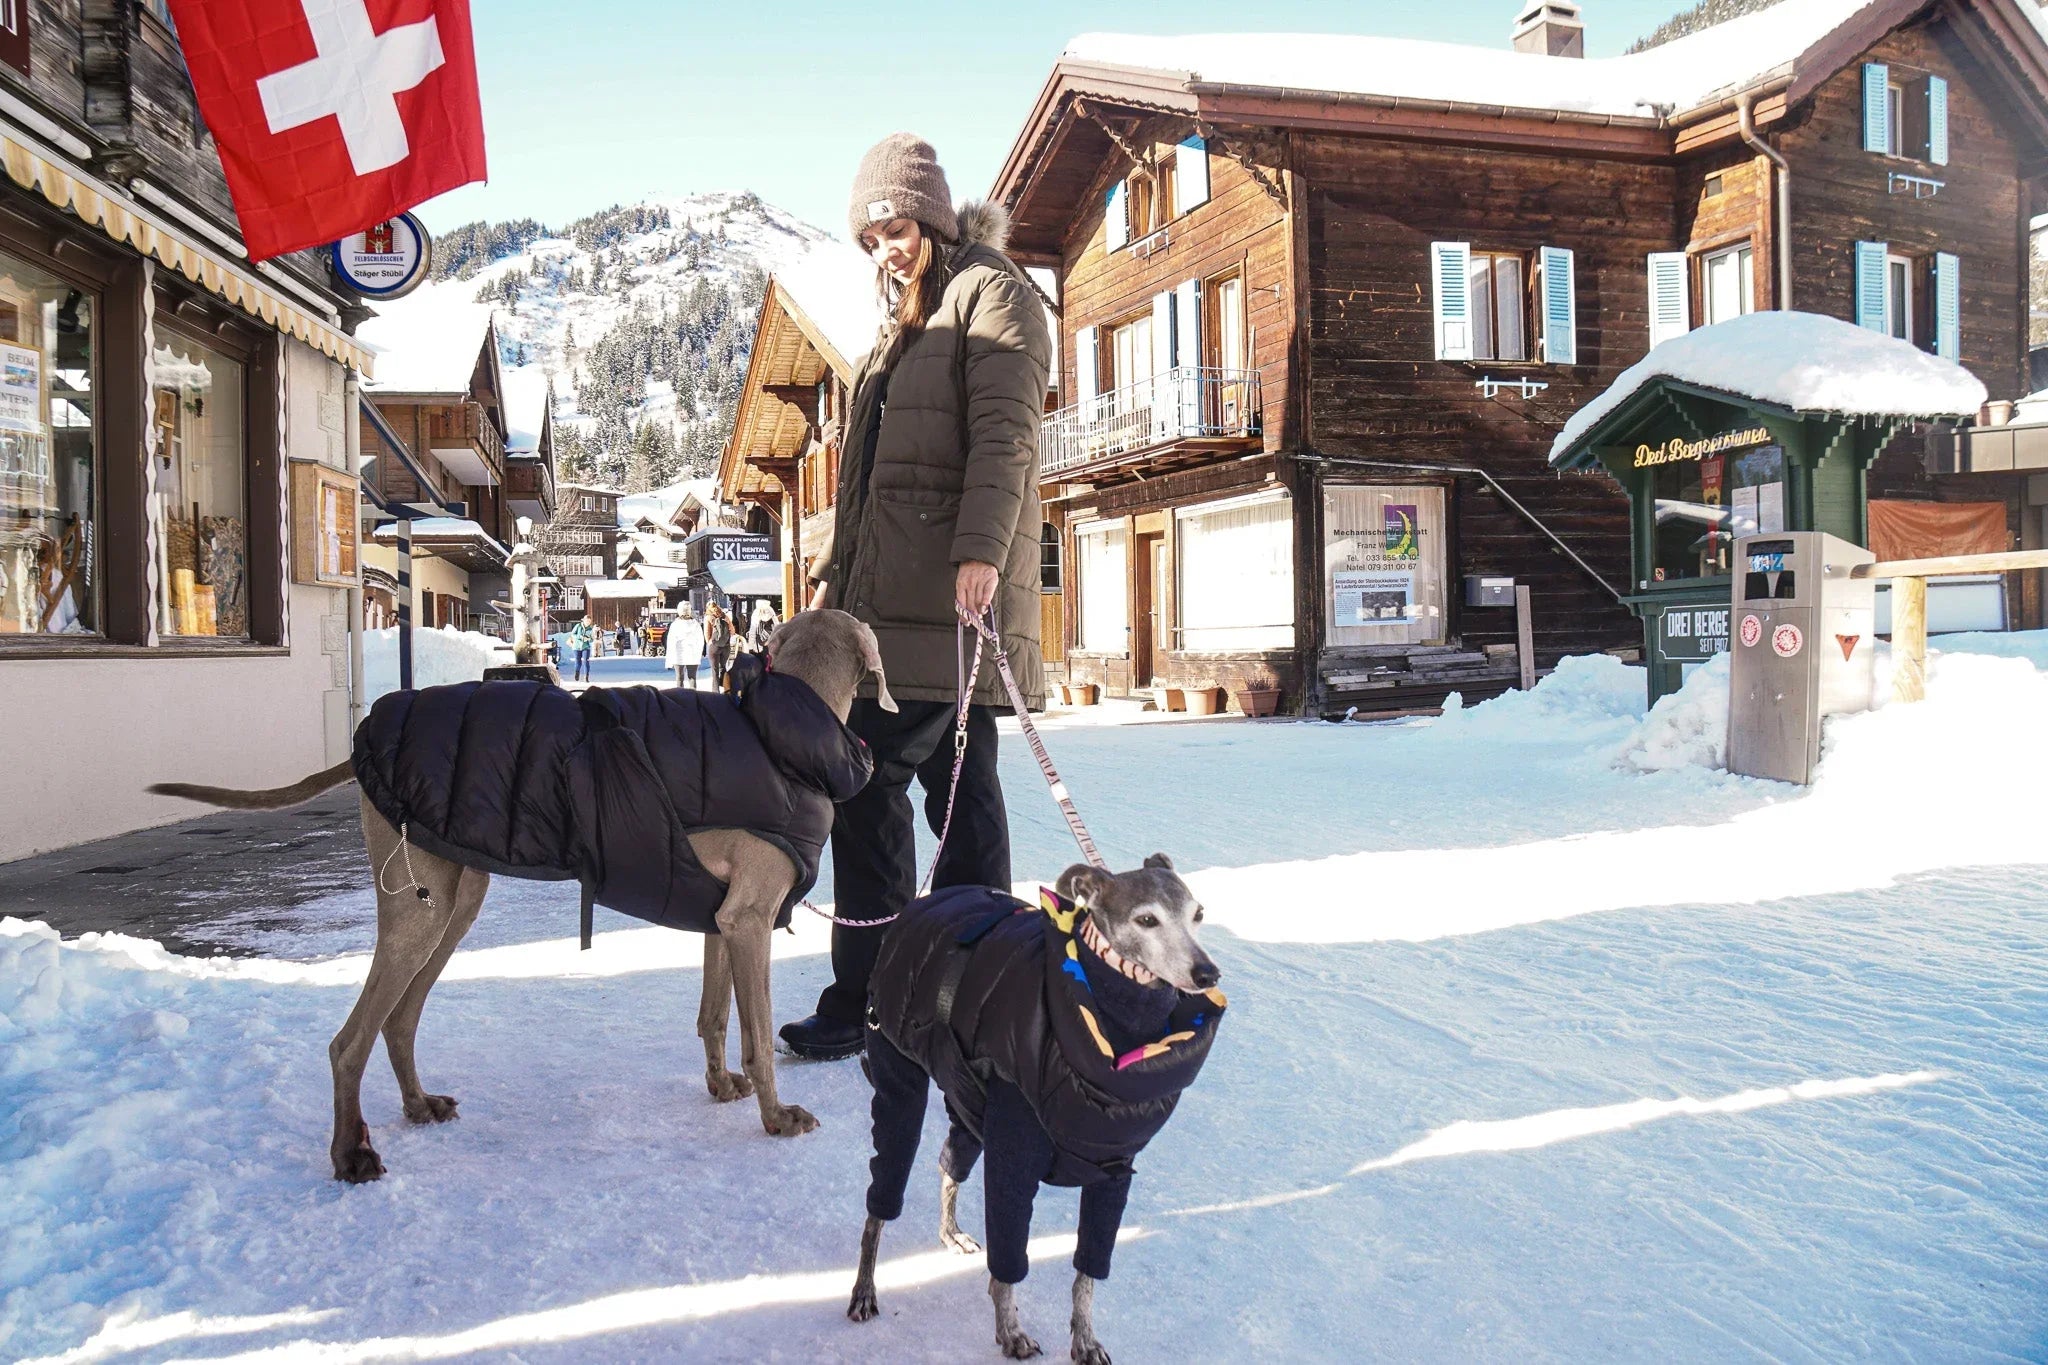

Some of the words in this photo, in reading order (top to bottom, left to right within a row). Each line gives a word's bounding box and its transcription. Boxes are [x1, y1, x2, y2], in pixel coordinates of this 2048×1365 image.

[354, 270, 379, 278] Stäger
[713, 543, 740, 560] SKI
[1668, 612, 1690, 637] DREI
[1695, 610, 1729, 636] BERGE
[1700, 638, 1713, 652] SEIT
